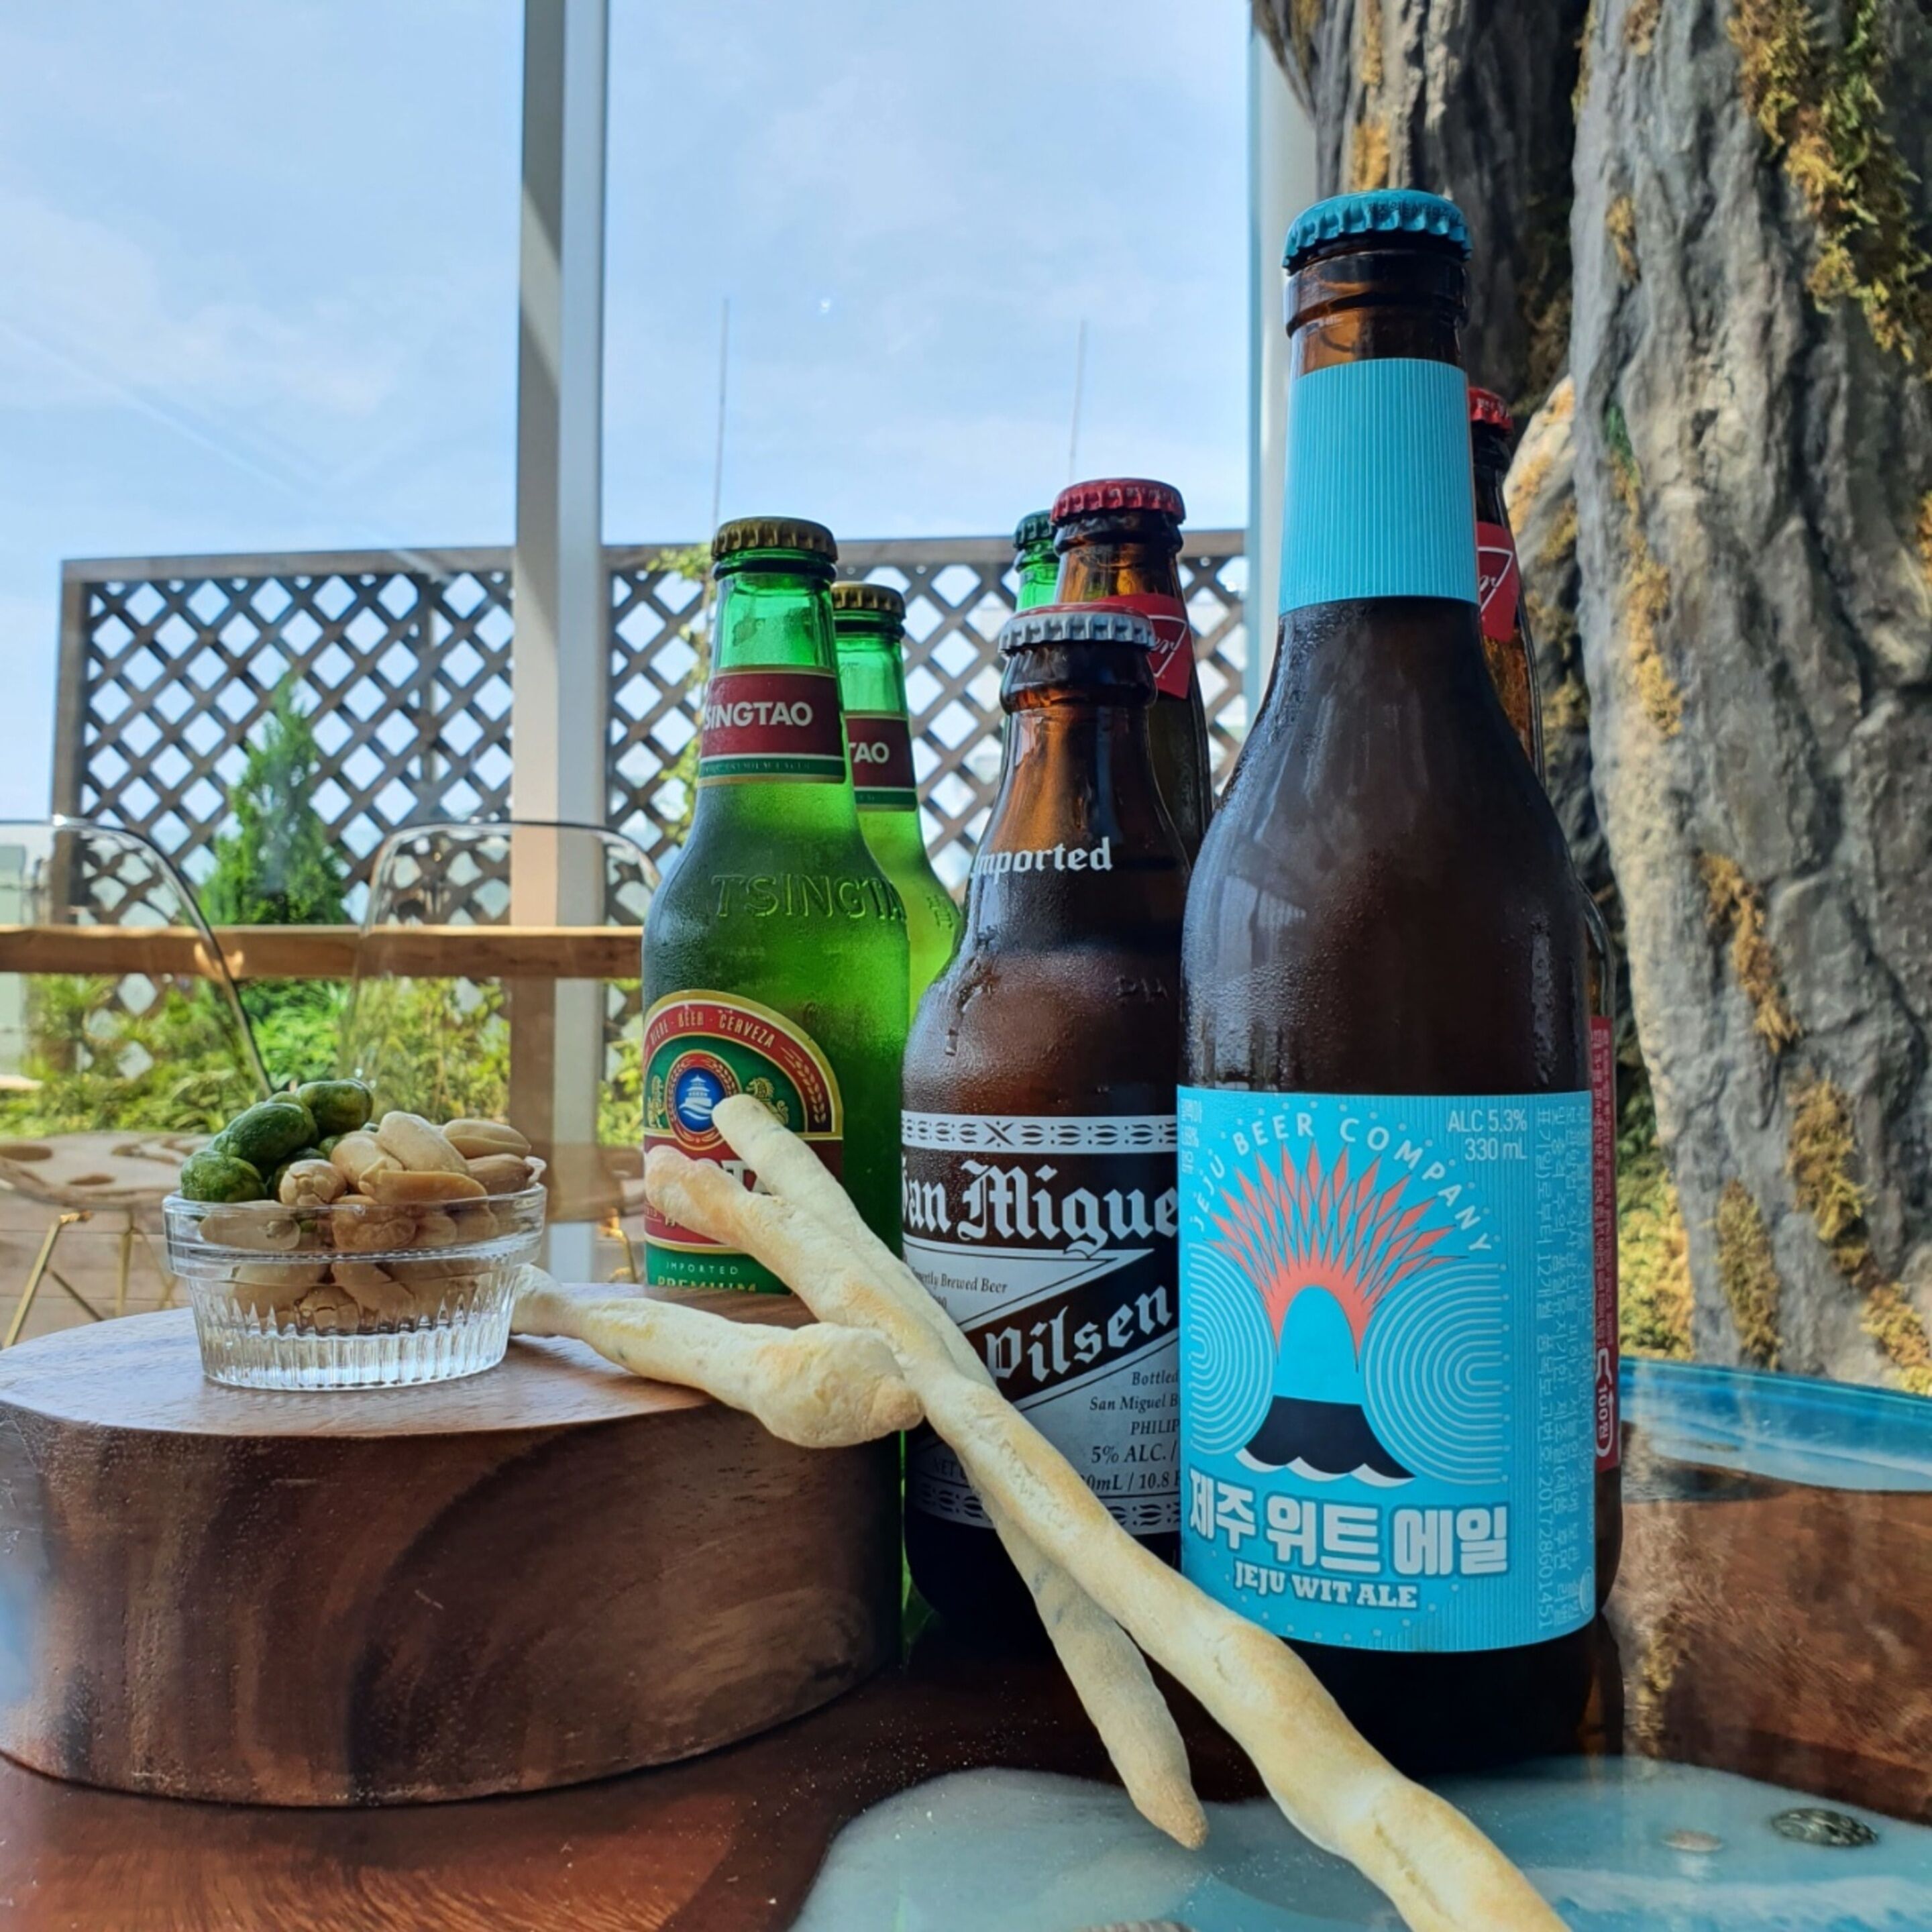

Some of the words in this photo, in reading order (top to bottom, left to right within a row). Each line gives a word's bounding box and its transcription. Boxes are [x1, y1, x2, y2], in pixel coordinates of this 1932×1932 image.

[678, 1011, 704, 1028] BEER
[718, 1013, 776, 1048] CERVEZA
[1447, 1109, 1483, 1132] ALC
[1488, 1109, 1527, 1132] 5.3%
[1464, 1137, 1499, 1161] 330
[1503, 1136, 1528, 1160] mL
[1193, 1155, 1225, 1232] JEJU
[1232, 1112, 1315, 1156] BEER
[1340, 1118, 1491, 1250] COMPANY
[1535, 1108, 1553, 1244] 표기일)로부터
[957, 1159, 1178, 1258] Migue
[666, 1262, 738, 1275] IMPORTED
[941, 1273, 978, 1291] Brewed
[981, 1277, 1008, 1293] Beer
[1536, 1252, 1553, 1320] 12개월
[1089, 1396, 1116, 1411] San
[1120, 1393, 1167, 1413] Miguel
[1091, 1445, 1120, 1464] 5%
[1124, 1443, 1167, 1463] ALC.
[1140, 1471, 1170, 1489] 10.8
[1189, 1466, 1256, 1550] 제주
[1266, 1493, 1381, 1573] 위트
[1393, 1505, 1508, 1575] 에일
[1234, 1560, 1285, 1595] JEJU
[1291, 1574, 1352, 1602] WIT
[1356, 1584, 1417, 1608] ALE
